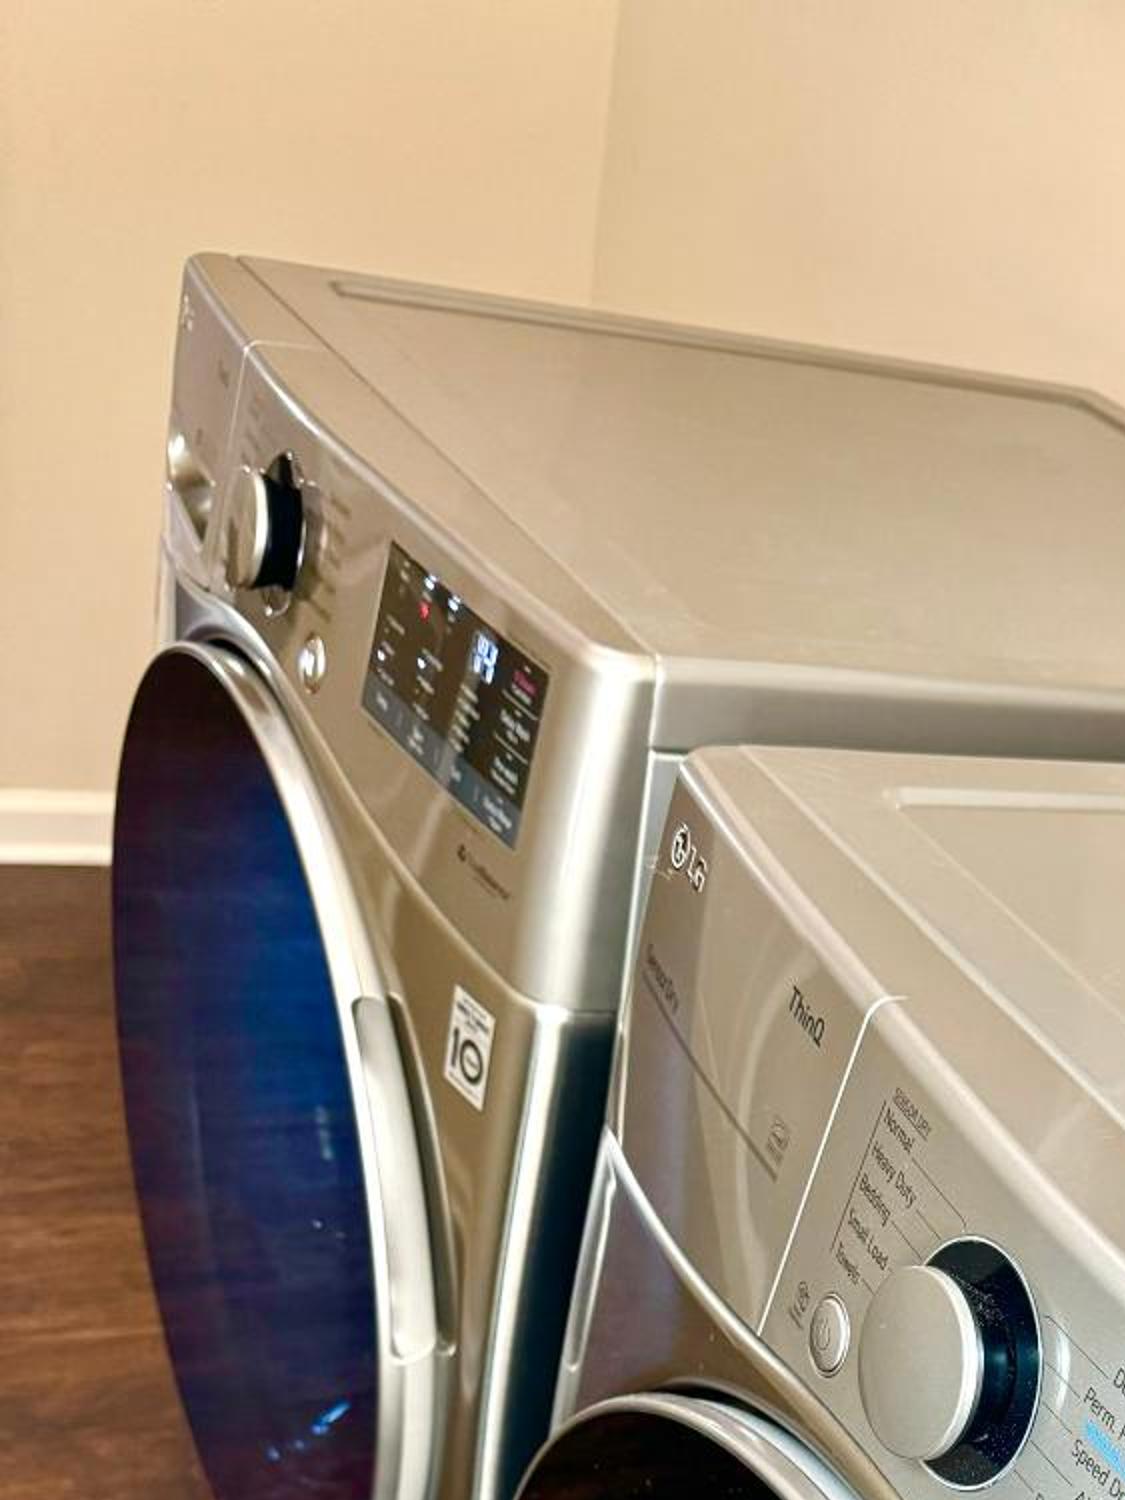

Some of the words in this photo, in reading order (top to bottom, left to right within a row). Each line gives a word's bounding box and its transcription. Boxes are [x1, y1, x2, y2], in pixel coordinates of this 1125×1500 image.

[686, 846, 709, 893] LG
[789, 985, 826, 1048] ThinQ
[883, 1107, 915, 1153] Normal
[871, 1141, 896, 1184] Heavy
[895, 1170, 917, 1209] Duty
[859, 1172, 891, 1228] Bedding
[867, 1236, 889, 1271] Load
[1083, 1386, 1116, 1434] Perm.
[1071, 1439, 1110, 1487] Speed
